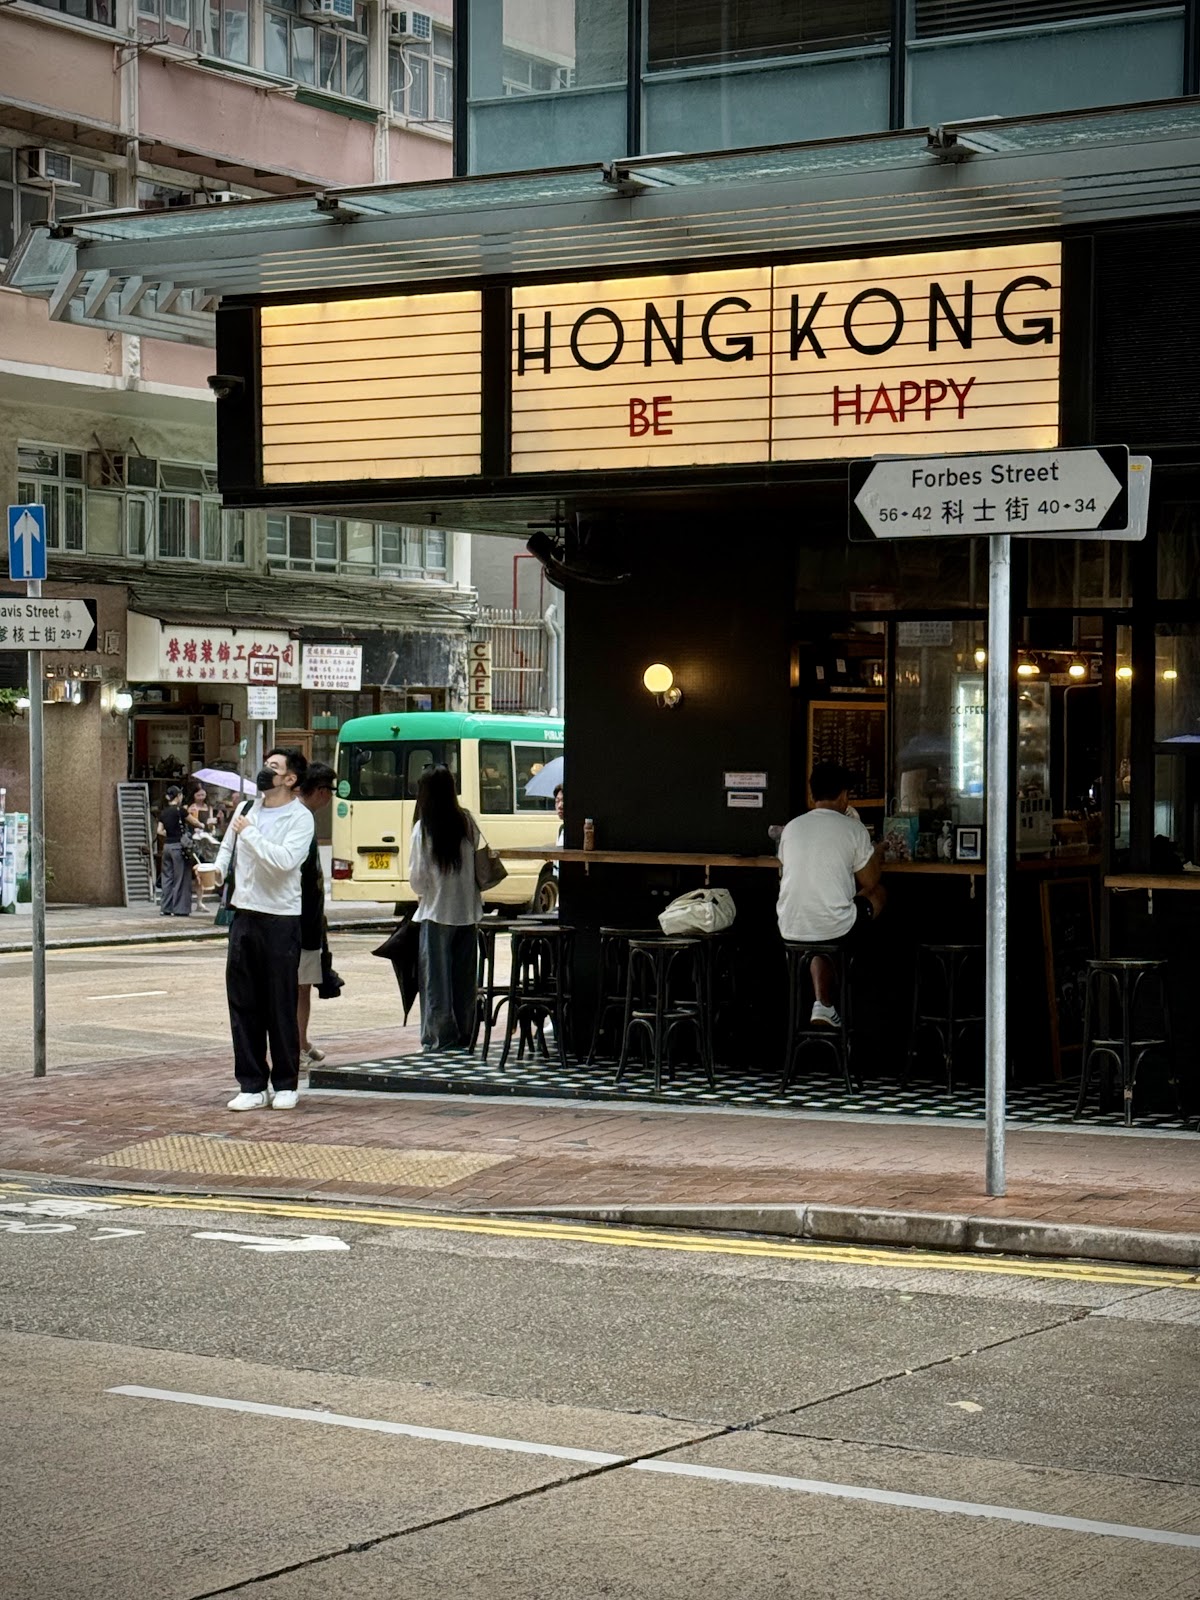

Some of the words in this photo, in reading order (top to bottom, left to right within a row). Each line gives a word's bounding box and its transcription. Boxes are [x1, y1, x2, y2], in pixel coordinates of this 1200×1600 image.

[517, 296, 753, 376] HONG
[790, 275, 1054, 361] KONG
[629, 396, 673, 437] BE
[833, 376, 976, 427] HAPPY
[912, 463, 982, 488] Forbes
[990, 461, 1059, 484] Street
[941, 496, 1029, 524] 科士街
[0, 604, 22, 618] avis
[26, 604, 60, 618] Street
[473, 644, 487, 710] CAFE
